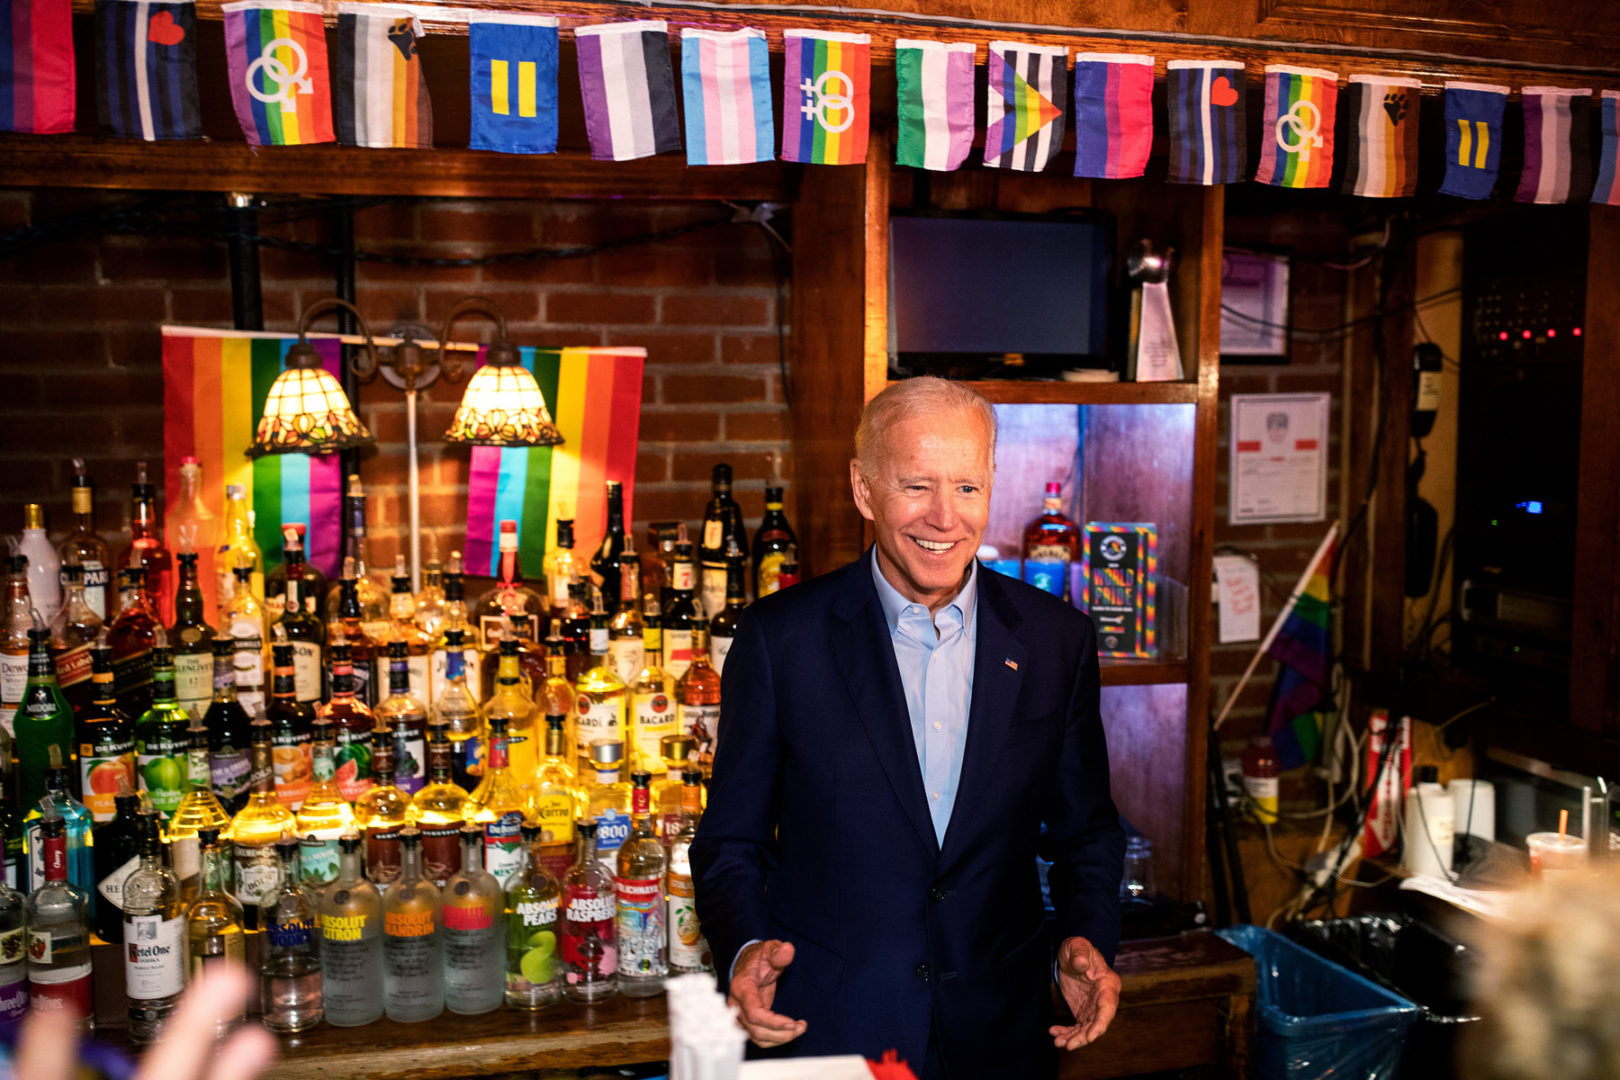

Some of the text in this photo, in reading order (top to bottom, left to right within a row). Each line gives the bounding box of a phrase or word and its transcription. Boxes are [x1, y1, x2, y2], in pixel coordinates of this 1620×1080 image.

[599, 824, 628, 839] 800
[664, 821, 682, 835] 18
[52, 849, 64, 869] Cherry
[321, 913, 368, 928] ABSOLUT
[522, 909, 558, 926] PEARS
[322, 926, 362, 942] CITRON
[152, 944, 171, 956] One
